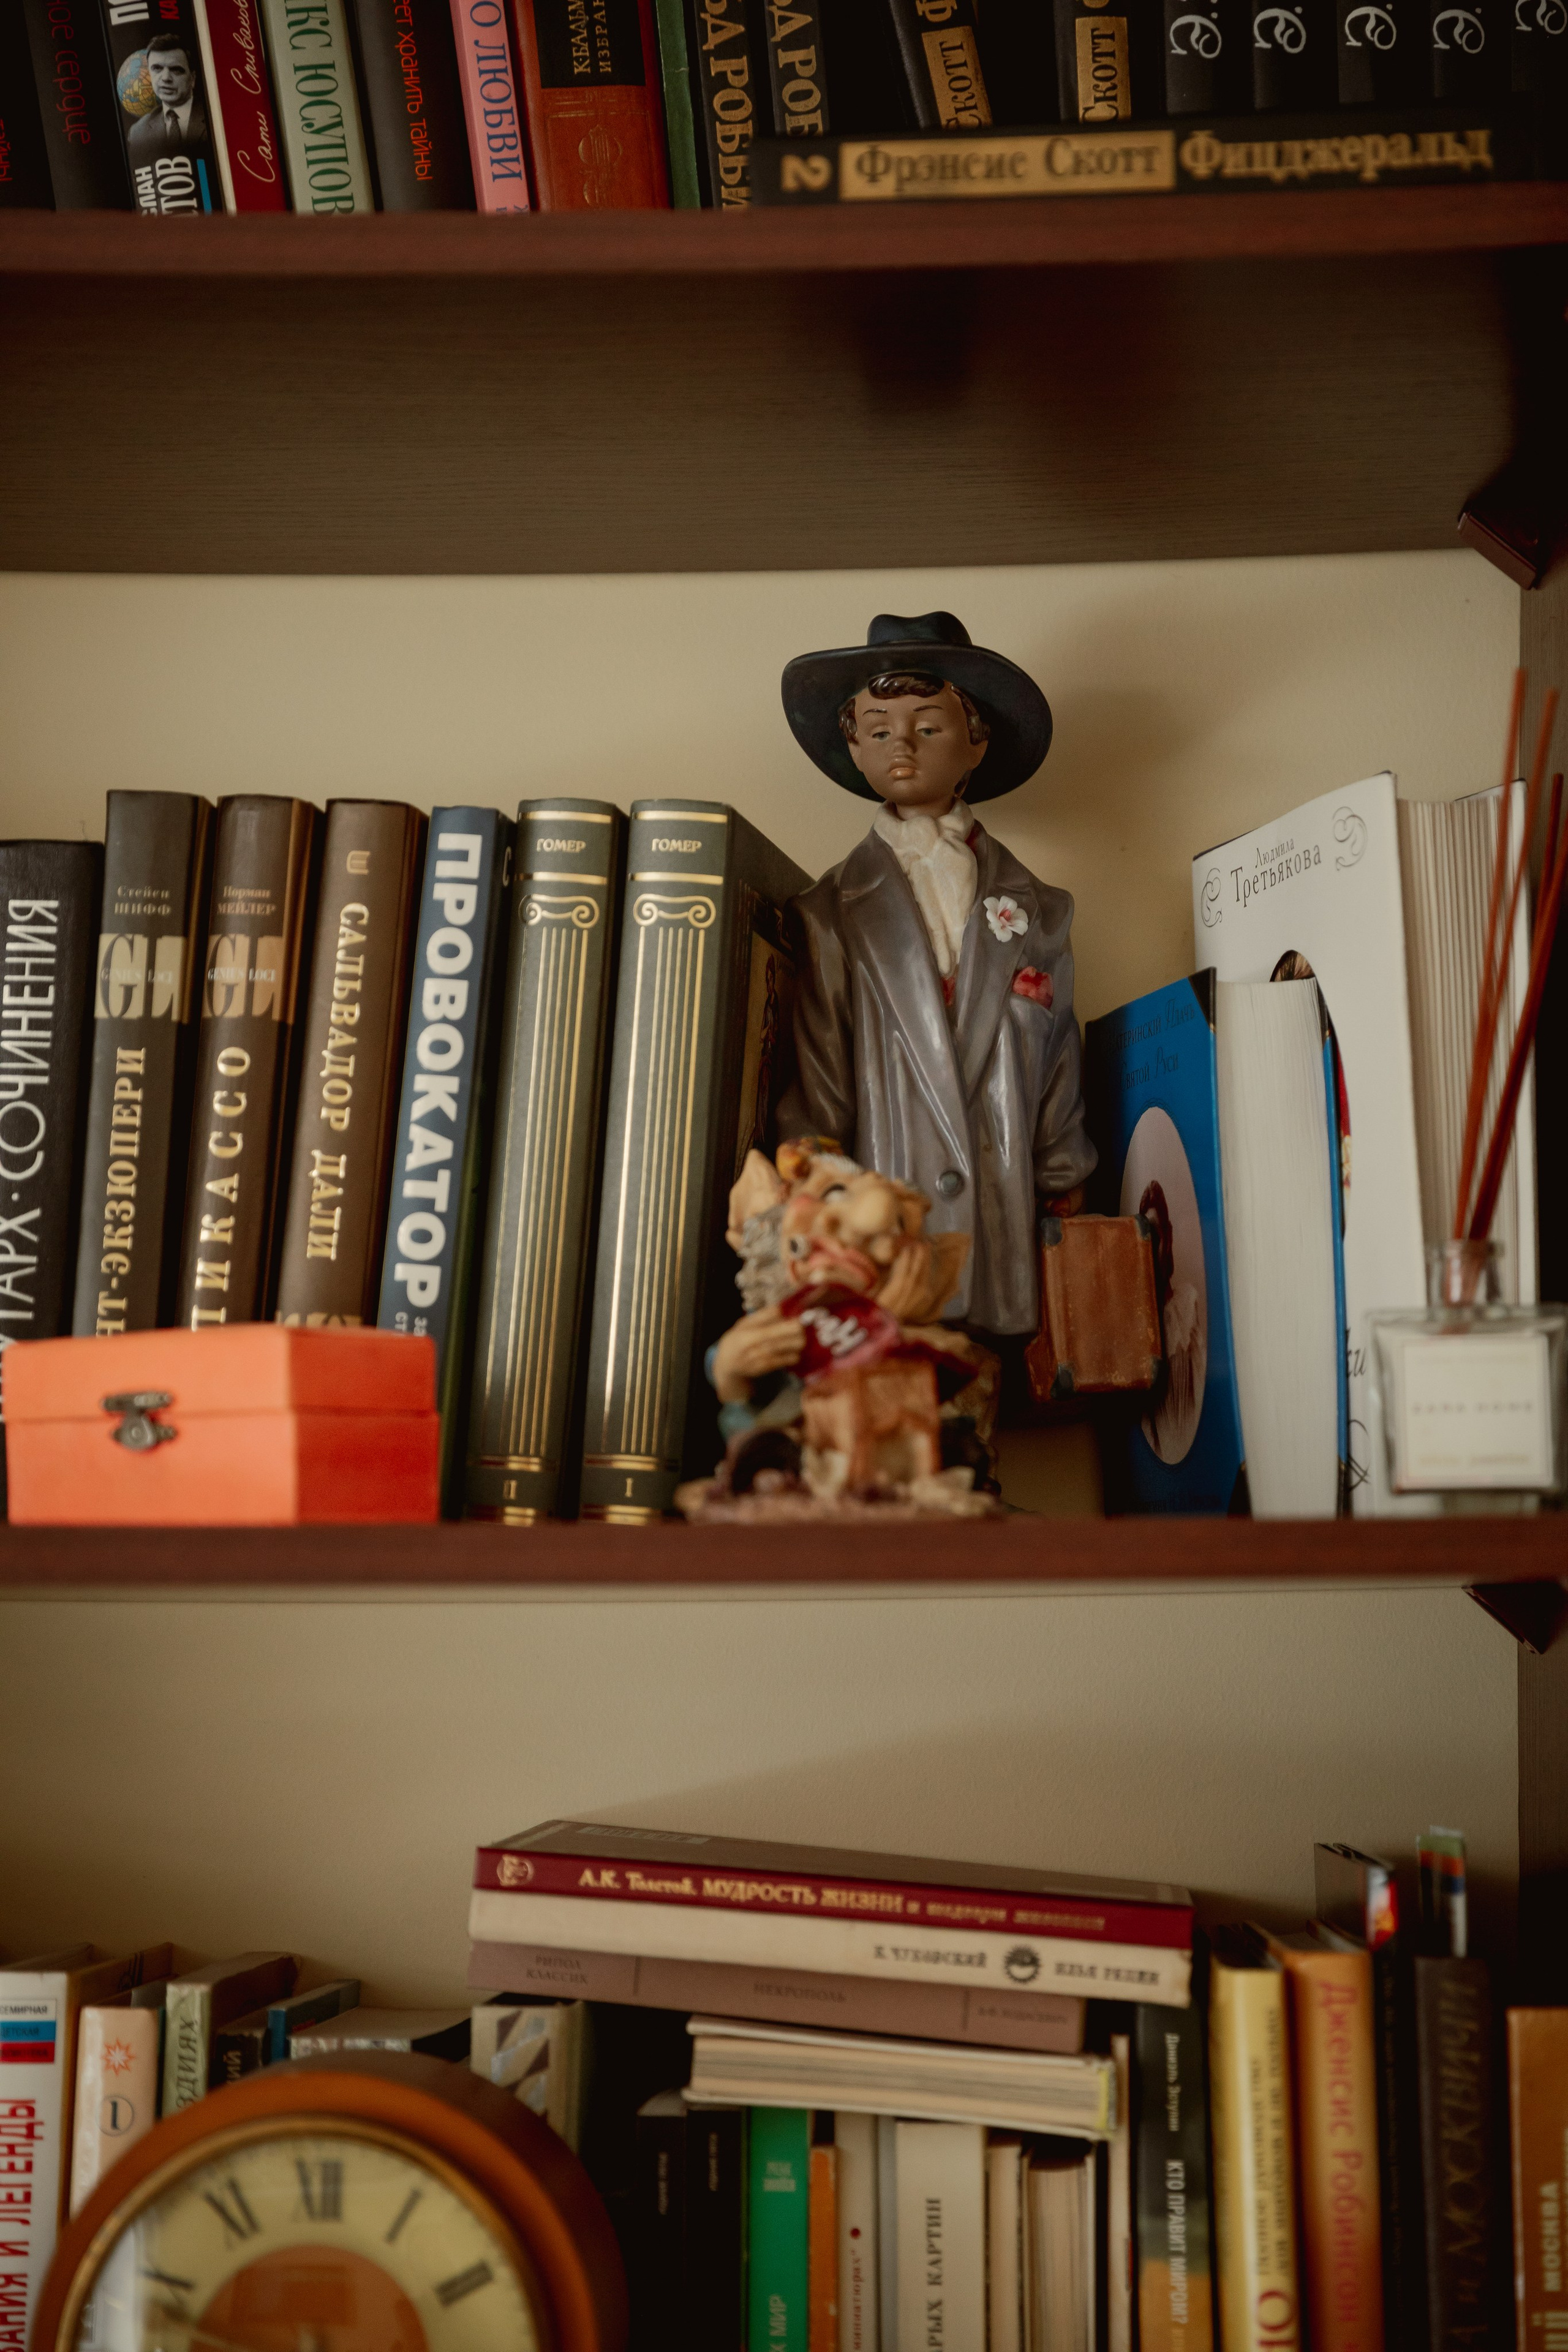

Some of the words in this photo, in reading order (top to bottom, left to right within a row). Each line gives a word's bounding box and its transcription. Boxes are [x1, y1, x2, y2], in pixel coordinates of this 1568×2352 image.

[52, 50, 91, 145] сердце
[395, 31, 423, 114] хранить
[409, 118, 435, 181] тайны
[473, 40, 523, 182] ЛЮБВИ
[1082, 28, 1119, 123] Скотт
[236, 111, 276, 183] Сати
[293, 61, 355, 213] ЮСУПОВ
[781, 153, 832, 192] 2
[856, 145, 1028, 192] Фрэнсис
[1044, 135, 1159, 178] Скотт
[1180, 129, 1494, 183] Фицджеральд
[536, 838, 586, 853] ГОМЕР
[651, 838, 703, 853] ГОМЕР
[1231, 845, 1322, 908] Третьякова
[1255, 838, 1295, 869] Людмила
[114, 902, 172, 916] ШИФФ
[216, 901, 277, 916] МЕЙЛЕР
[222, 885, 272, 900] Норман
[0, 899, 59, 1181] СОЧИНЕНИЯ
[320, 902, 369, 1132] САЛЬВАДОР
[394, 832, 483, 1309] ПРОВОКАТОР
[307, 1149, 347, 1261] ДАЛИ
[701, 1877, 817, 1905] МУДРОСТЬ
[1316, 1980, 1362, 2138] Дженсис
[1166, 2158, 1187, 2191] КТО
[925, 2198, 943, 2286] КАРТИН
[1166, 2192, 1188, 2254] ПРАВИТ
[1330, 2147, 1364, 2324] Робинсон
[1539, 2181, 1562, 2293] МОСКВА
[925, 2299, 943, 2352] РЫХ
[1168, 2256, 1189, 2325] МИРОМ?
